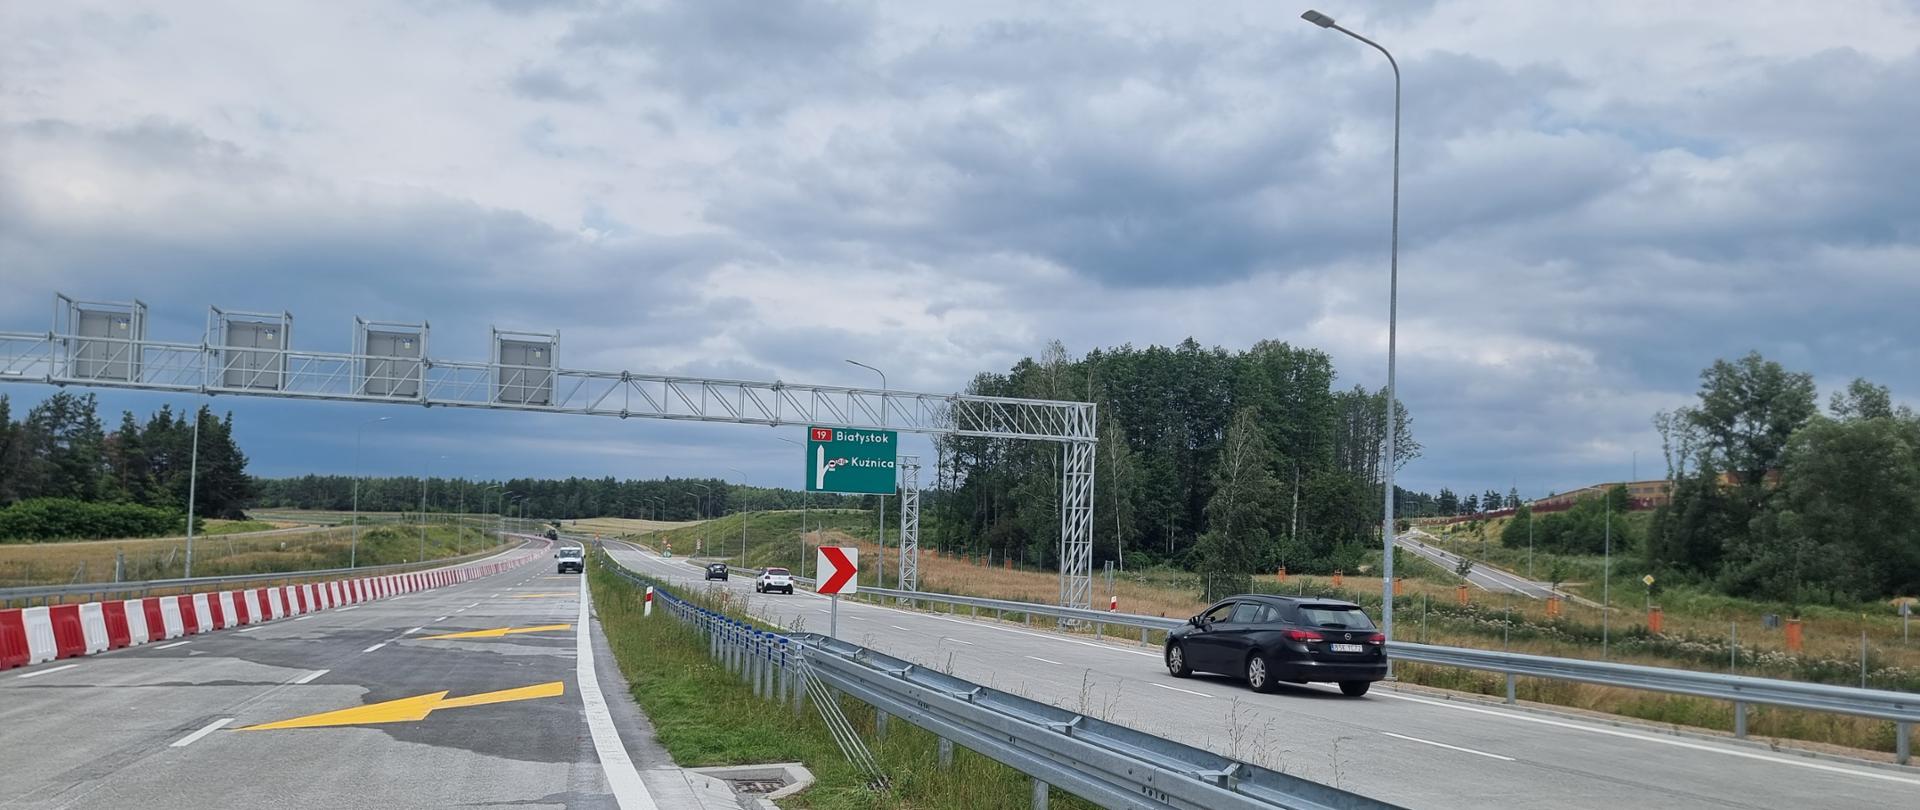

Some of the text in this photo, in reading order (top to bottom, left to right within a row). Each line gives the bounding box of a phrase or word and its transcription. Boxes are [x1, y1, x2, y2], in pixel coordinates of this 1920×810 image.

[817, 431, 888, 444] 19 Białystok
[852, 457, 894, 468] Kuźnica
